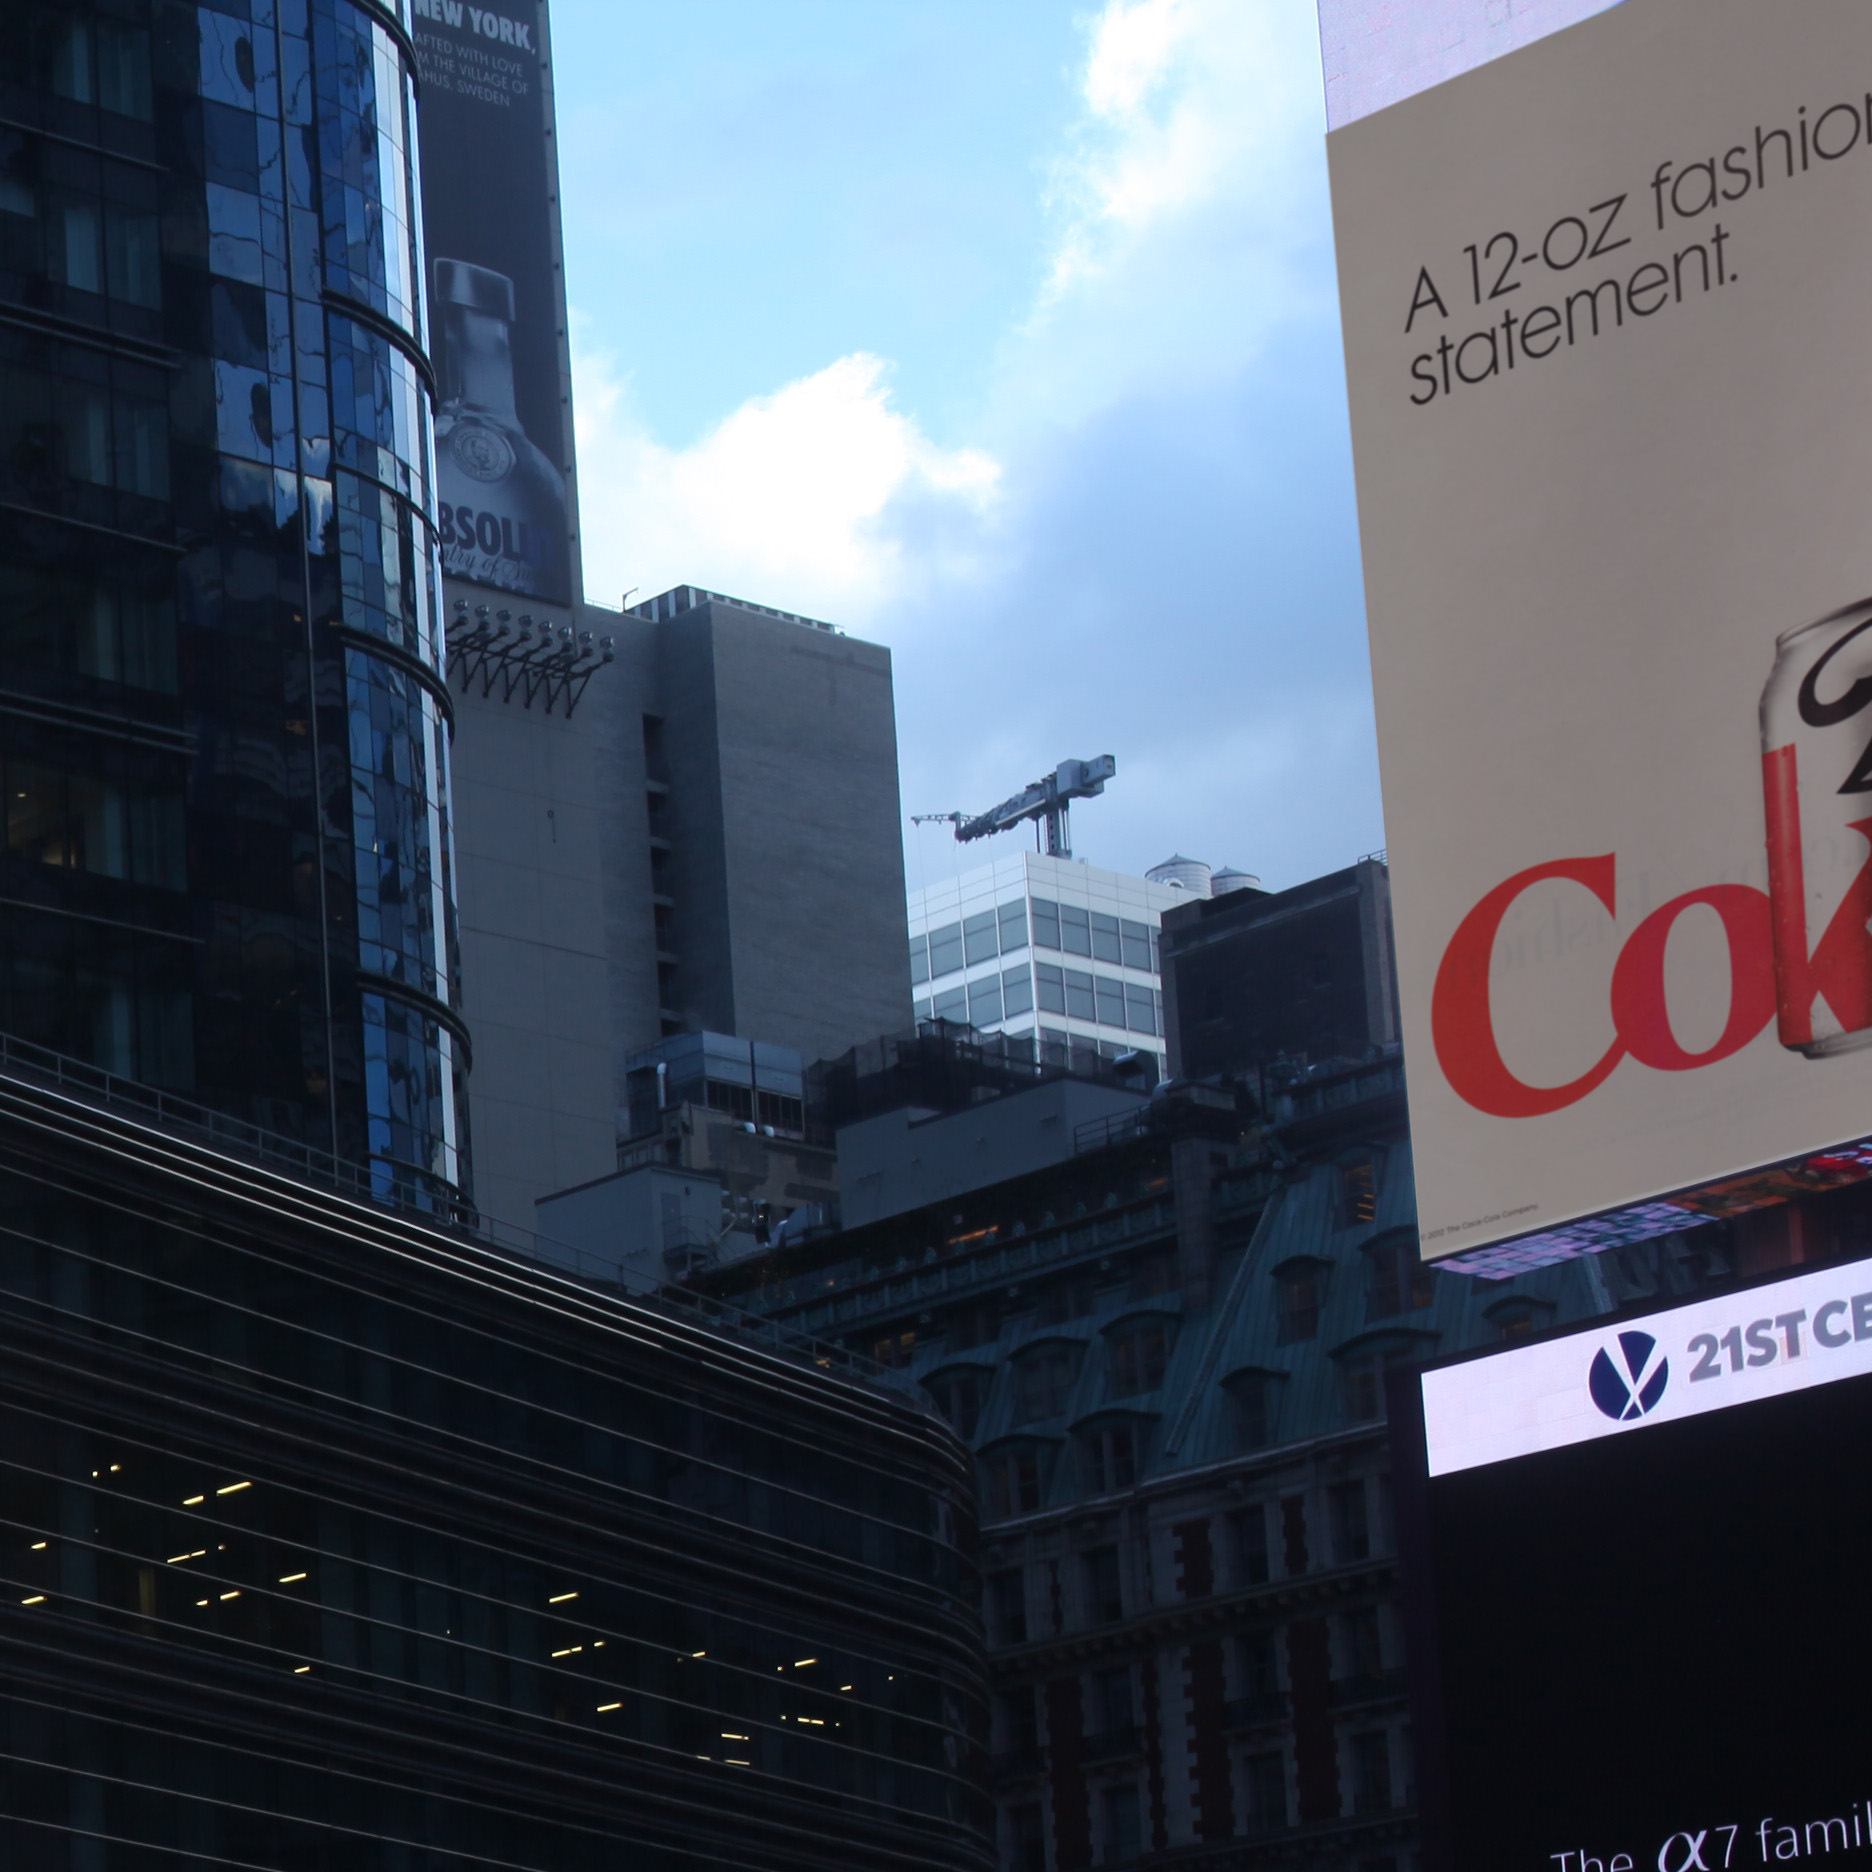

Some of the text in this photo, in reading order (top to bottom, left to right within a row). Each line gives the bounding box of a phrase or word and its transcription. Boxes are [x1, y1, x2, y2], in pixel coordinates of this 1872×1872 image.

[433, 52, 455, 73] THE
[458, 63, 508, 91] VILLAGE
[512, 81, 529, 96] OF
[456, 45, 489, 67] WITH
[492, 55, 523, 78] LOVE
[457, 79, 511, 107] SWEDEN
[1404, 92, 1872, 334] A 12-oz fashio
[1409, 223, 1738, 406] statement.
[1687, 1309, 1806, 1384] 21ST
